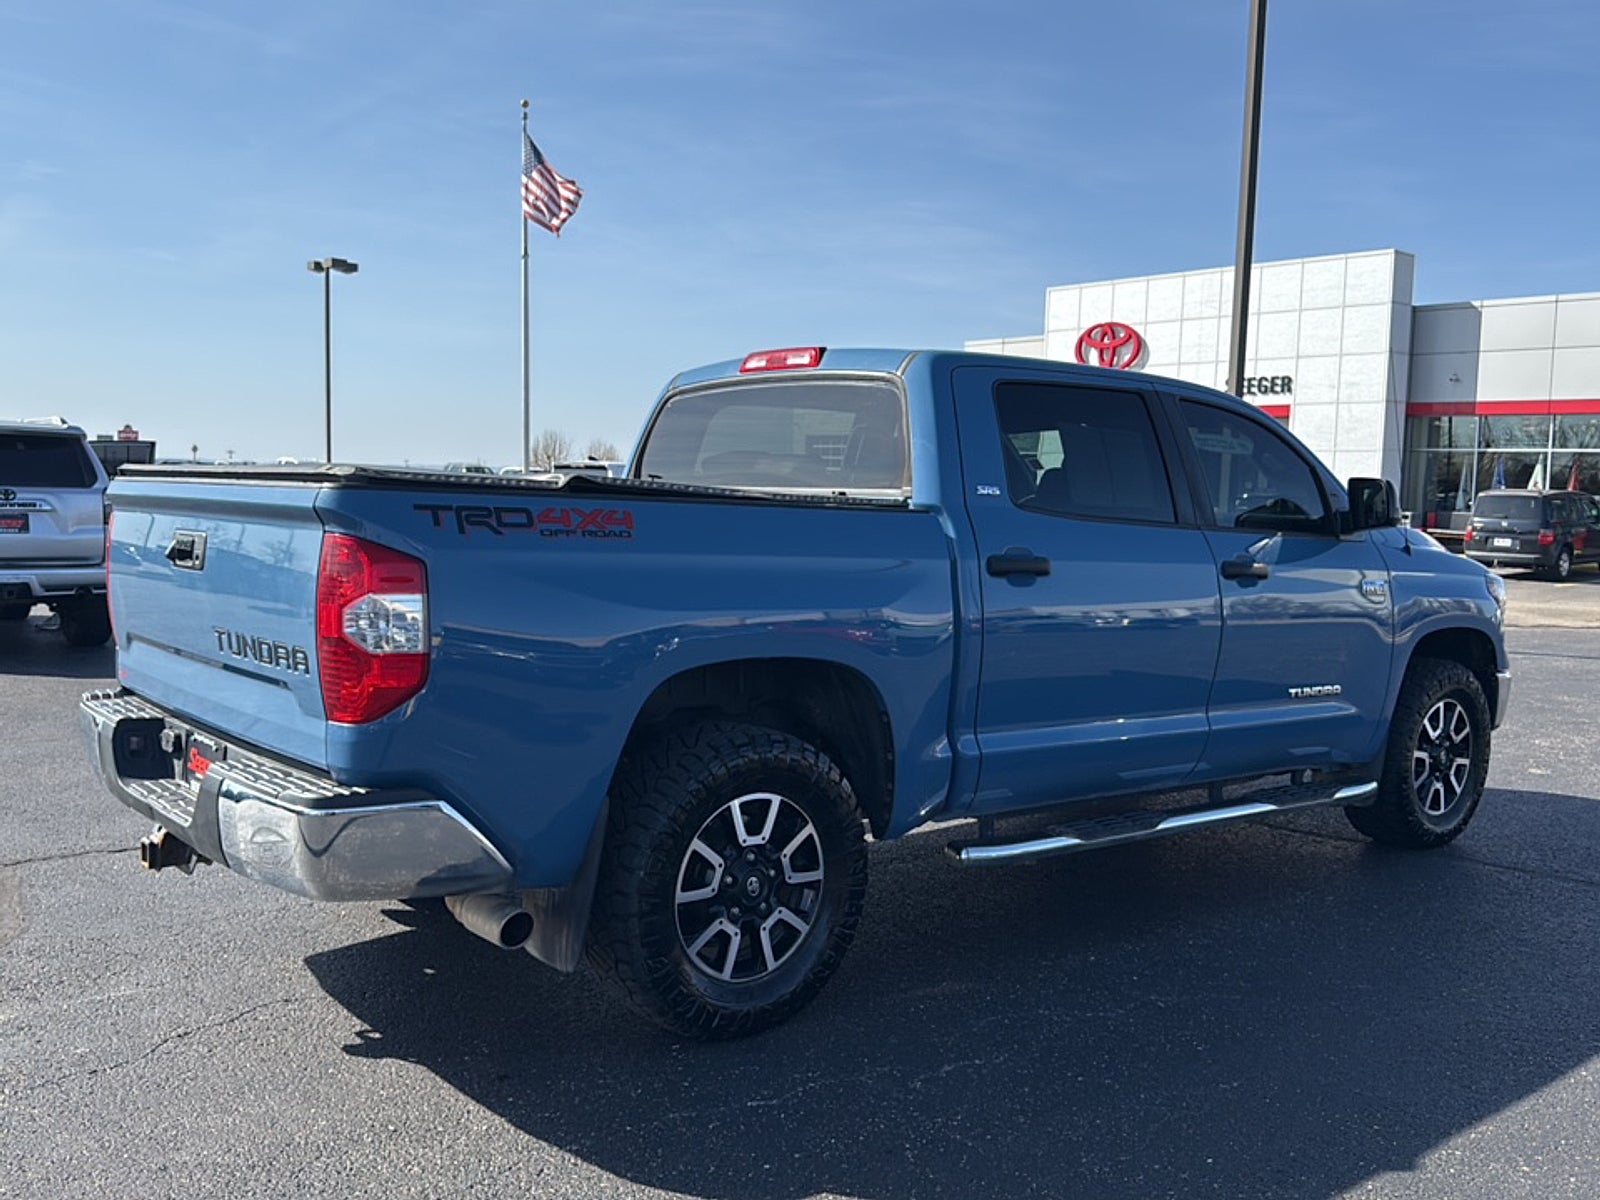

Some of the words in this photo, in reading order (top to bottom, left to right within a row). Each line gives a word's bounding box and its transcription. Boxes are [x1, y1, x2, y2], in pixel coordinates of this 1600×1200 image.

[1225, 375, 1294, 396] EGER
[540, 528, 577, 538] OFF
[581, 529, 633, 539] ROAD
[212, 626, 310, 677] TUNDRA
[1288, 684, 1341, 698] TUNDRA
